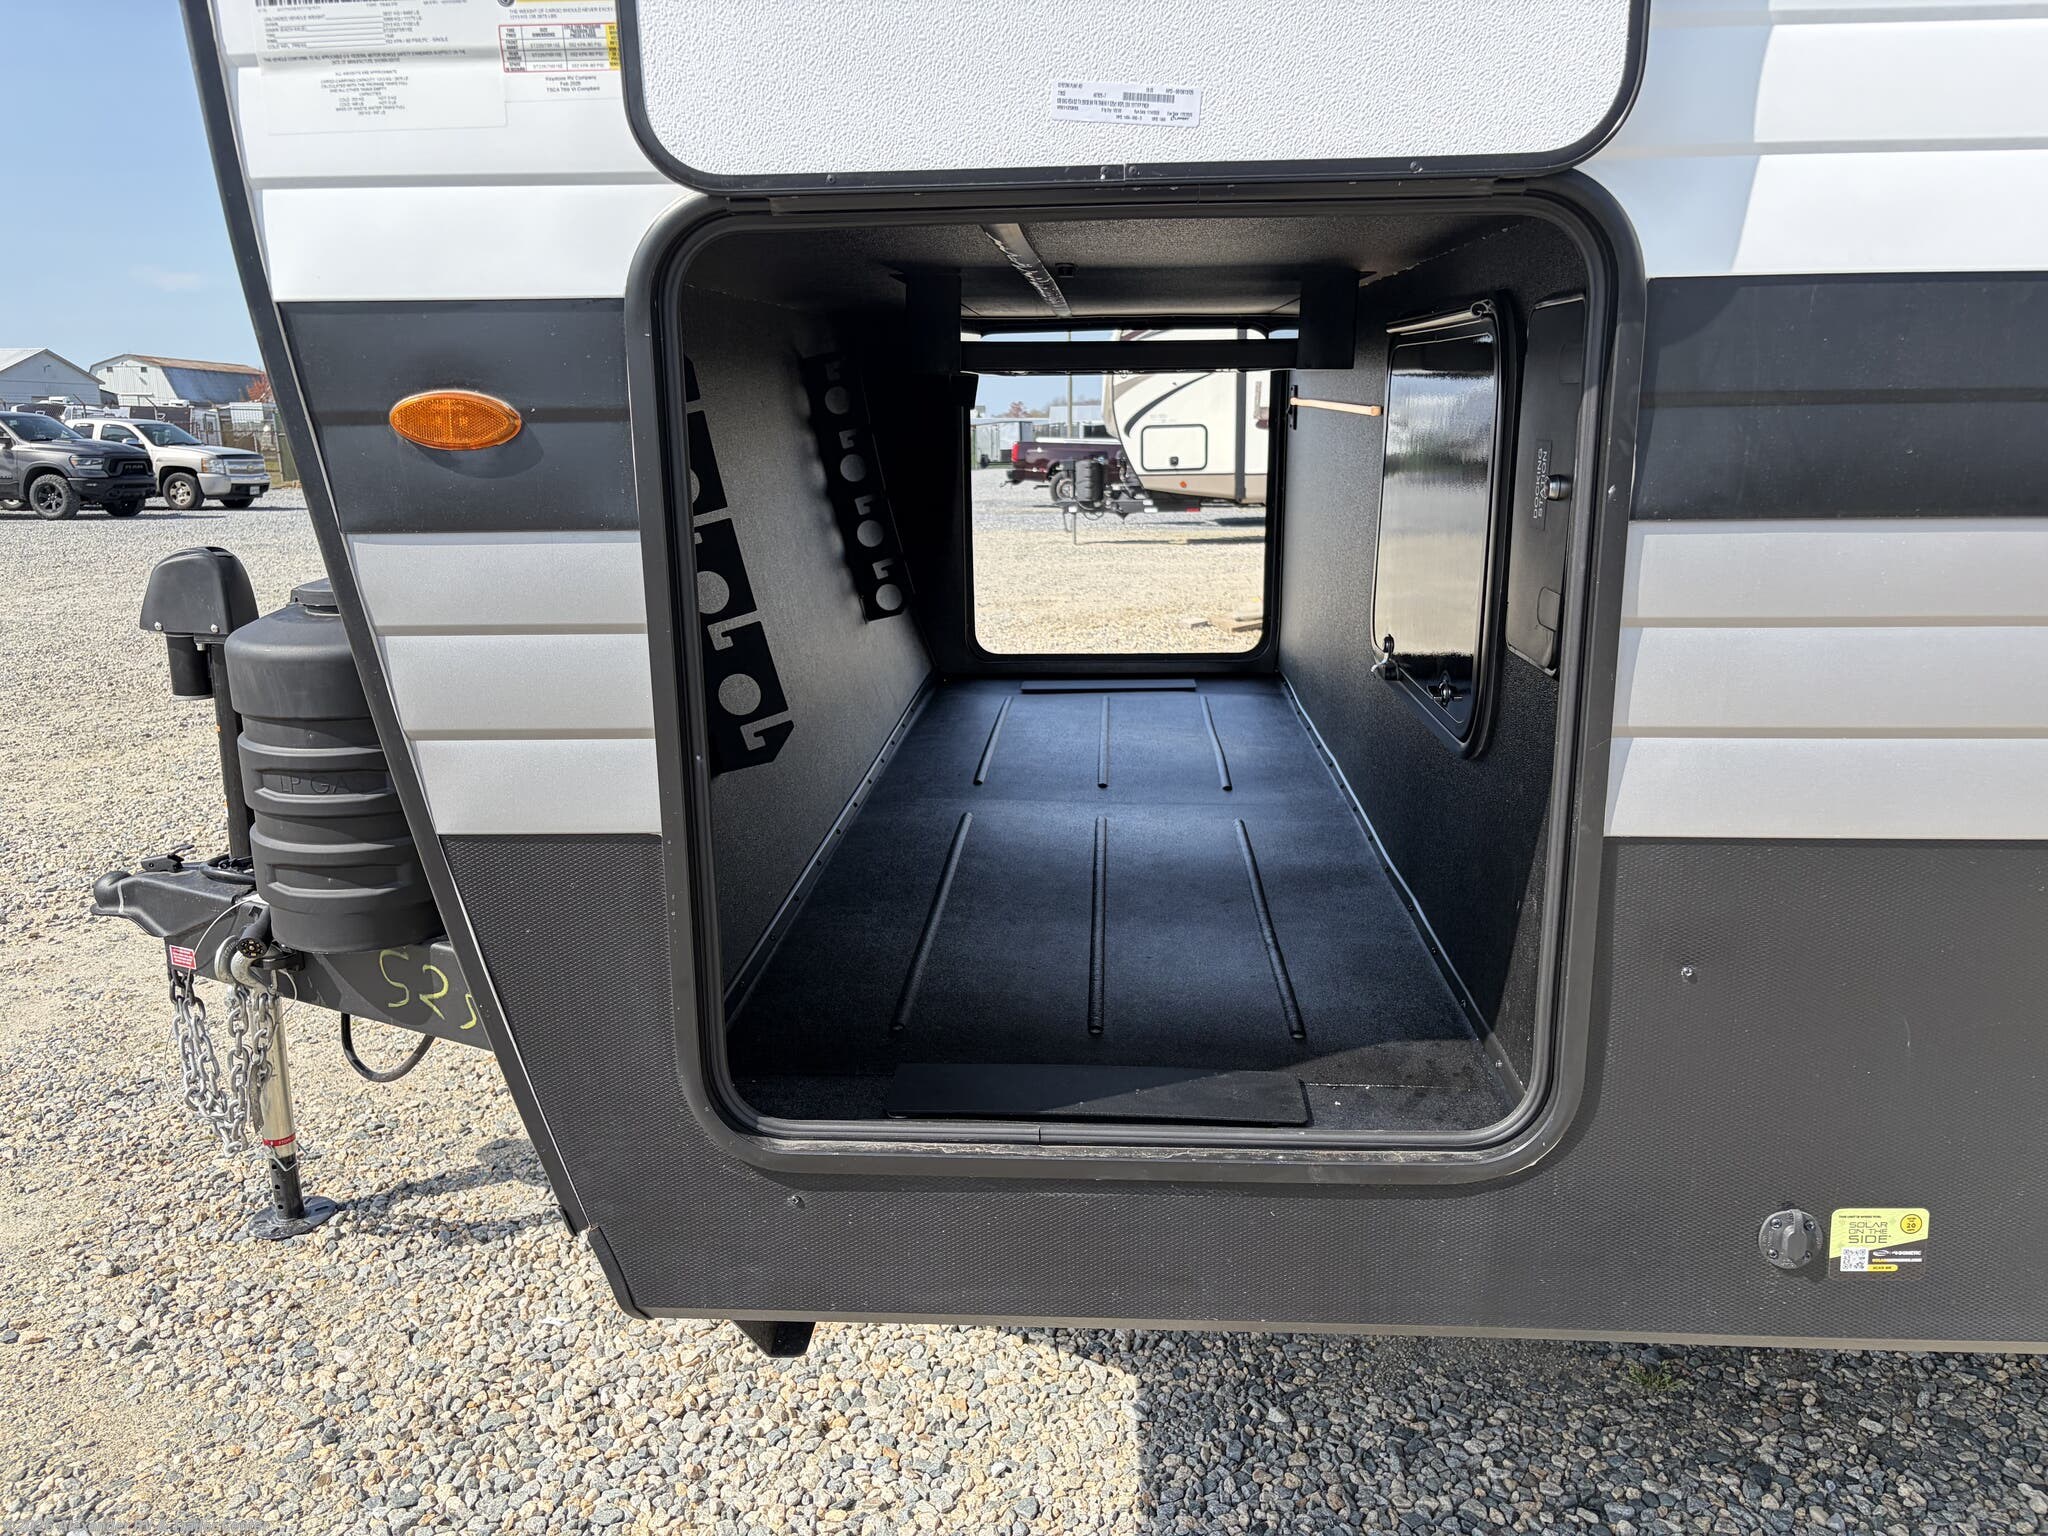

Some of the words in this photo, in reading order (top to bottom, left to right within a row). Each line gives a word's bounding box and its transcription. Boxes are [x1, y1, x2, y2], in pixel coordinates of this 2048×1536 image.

[1533, 448, 1543, 519] DOCKING
[1848, 1221, 1888, 1229] SOLAR
[1848, 1234, 1888, 1244] SIDE
